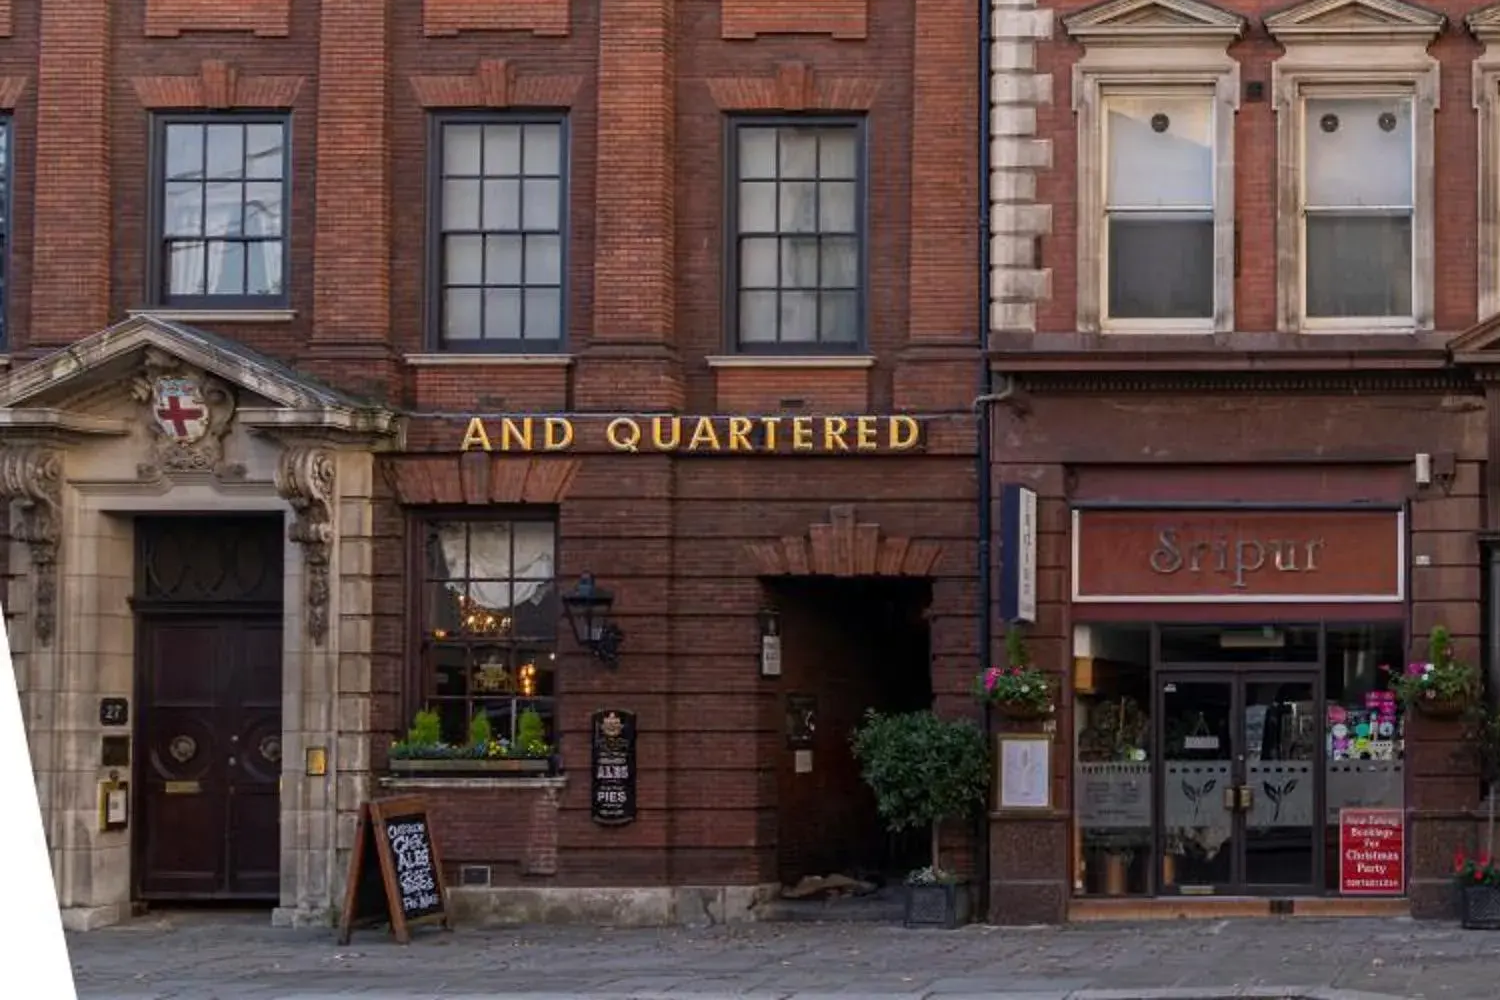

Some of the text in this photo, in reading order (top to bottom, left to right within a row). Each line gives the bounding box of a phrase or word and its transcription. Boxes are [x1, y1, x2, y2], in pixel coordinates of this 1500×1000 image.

[461, 415, 920, 453] AND QUARTERED
[1150, 528, 1325, 586] Sripur
[105, 704, 122, 719] 27
[597, 791, 627, 803] PIES
[1346, 849, 1399, 860] Christmas
[1357, 861, 1387, 875] Party
